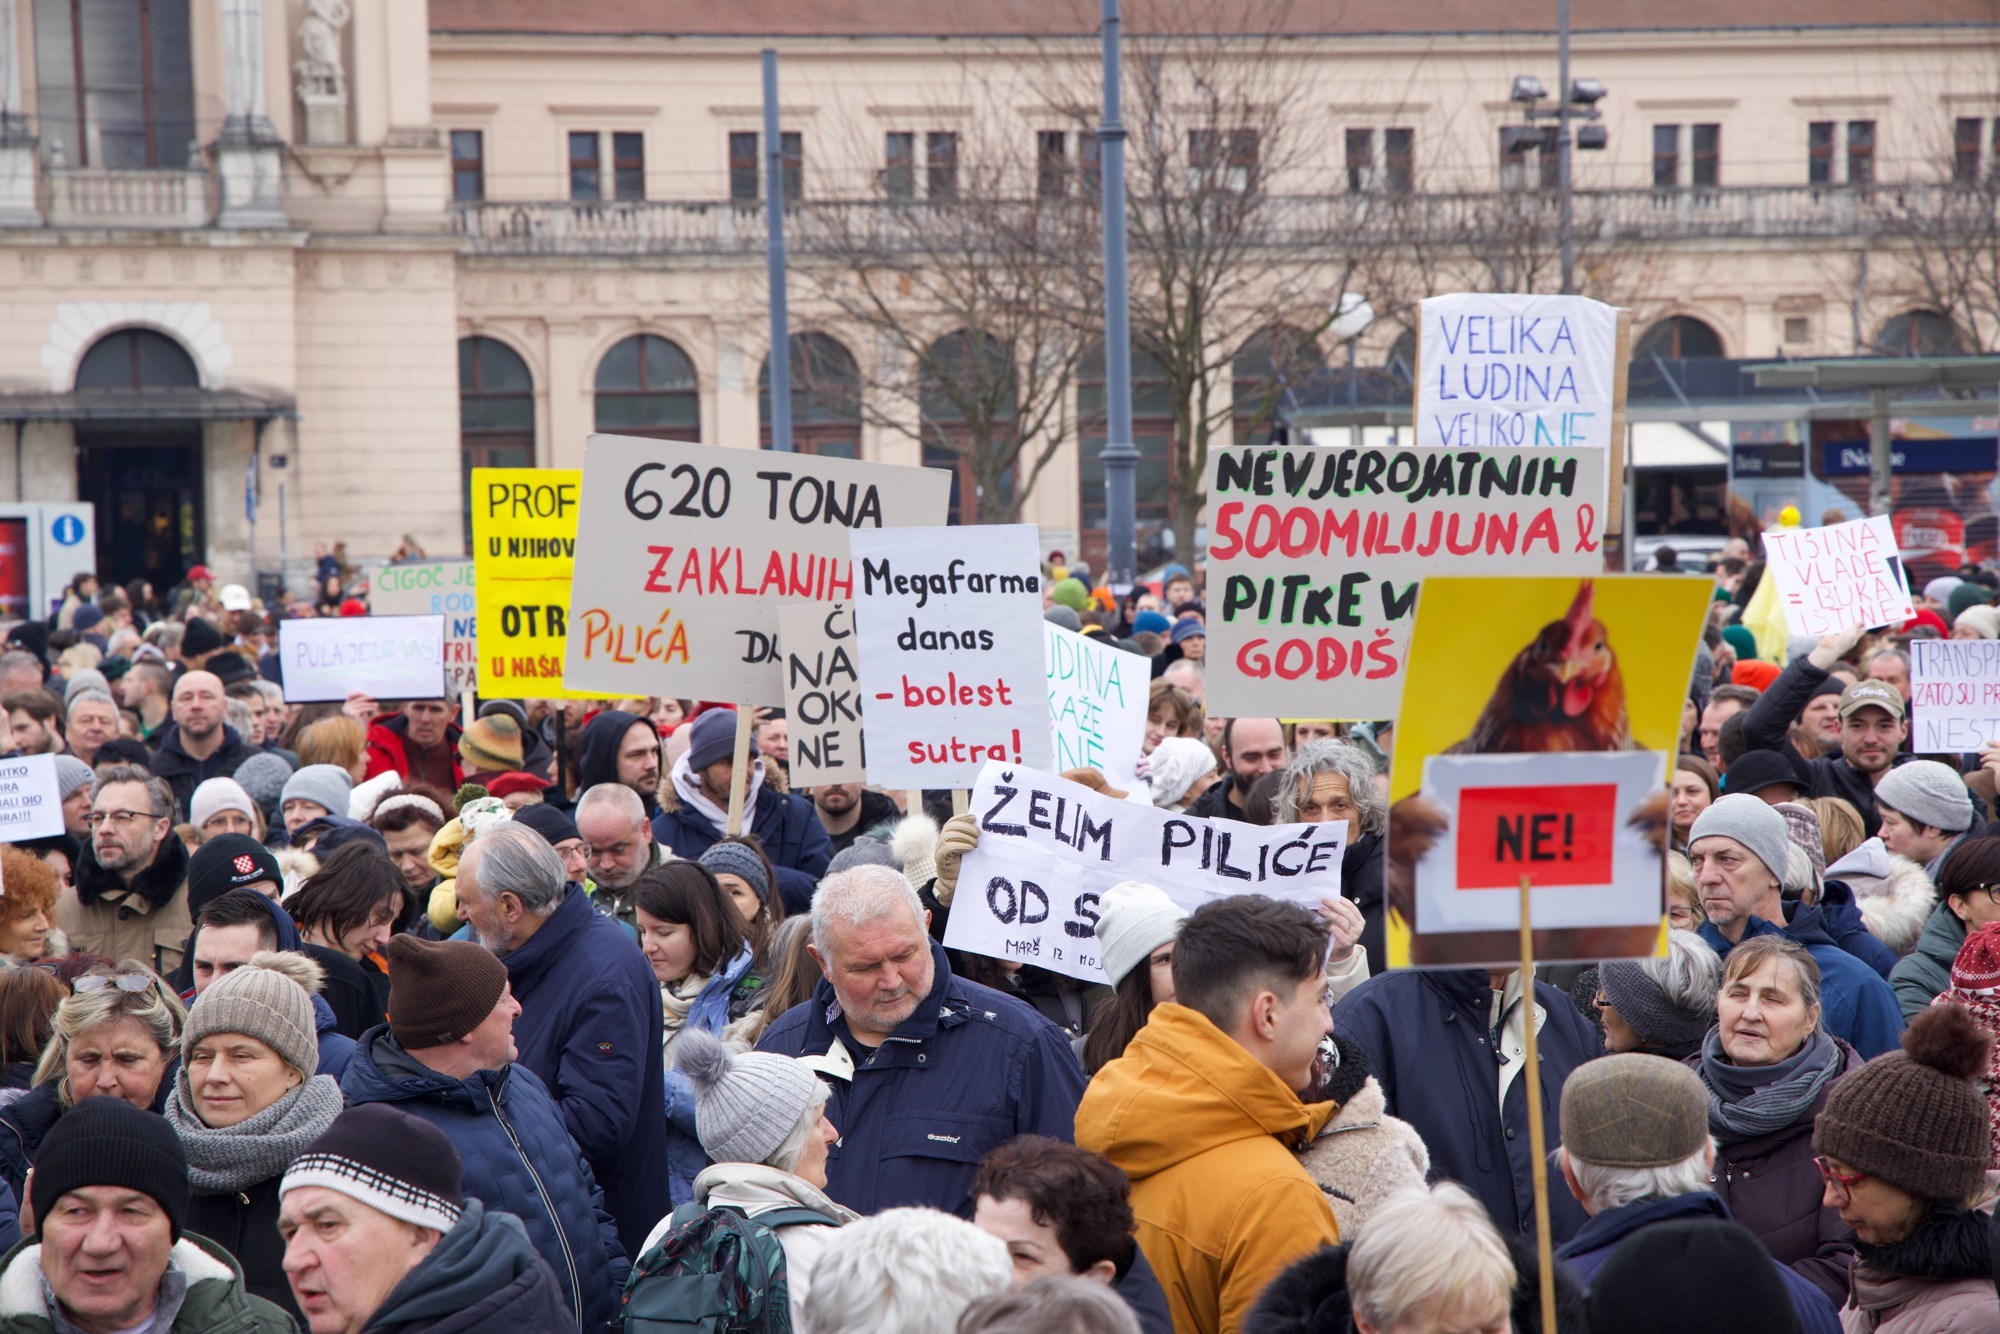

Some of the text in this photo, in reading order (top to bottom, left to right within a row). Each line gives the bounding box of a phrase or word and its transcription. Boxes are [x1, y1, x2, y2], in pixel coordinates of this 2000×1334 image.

[1440, 315, 1576, 355] VELIKA
[1440, 363, 1579, 404] LUDINA
[1435, 412, 1525, 446] VELIKO
[1216, 449, 1578, 503] NEVJEROJATNIH
[488, 483, 576, 519] PROF
[624, 462, 882, 528] 620 TONA
[489, 536, 575, 558] U NJIHOV
[1771, 522, 1880, 561] TIŠINA
[643, 545, 853, 601] ZAKLANIH
[1794, 550, 1883, 586] VLADE
[1815, 577, 1893, 609] BUKA
[579, 607, 690, 665] PILIĆA
[897, 617, 994, 651] danas
[297, 642, 343, 668] PULA
[492, 652, 562, 679] U NAŠA
[1914, 682, 1953, 707] ZATO
[1956, 682, 1975, 705] SU
[797, 731, 844, 769] NE
[910, 729, 1022, 765] sutra!
[22, 794, 42, 805] DIO
[981, 770, 1338, 882] ŽELIM PILIĆE
[1496, 813, 1574, 863] NE!
[986, 876, 1050, 926] OD
